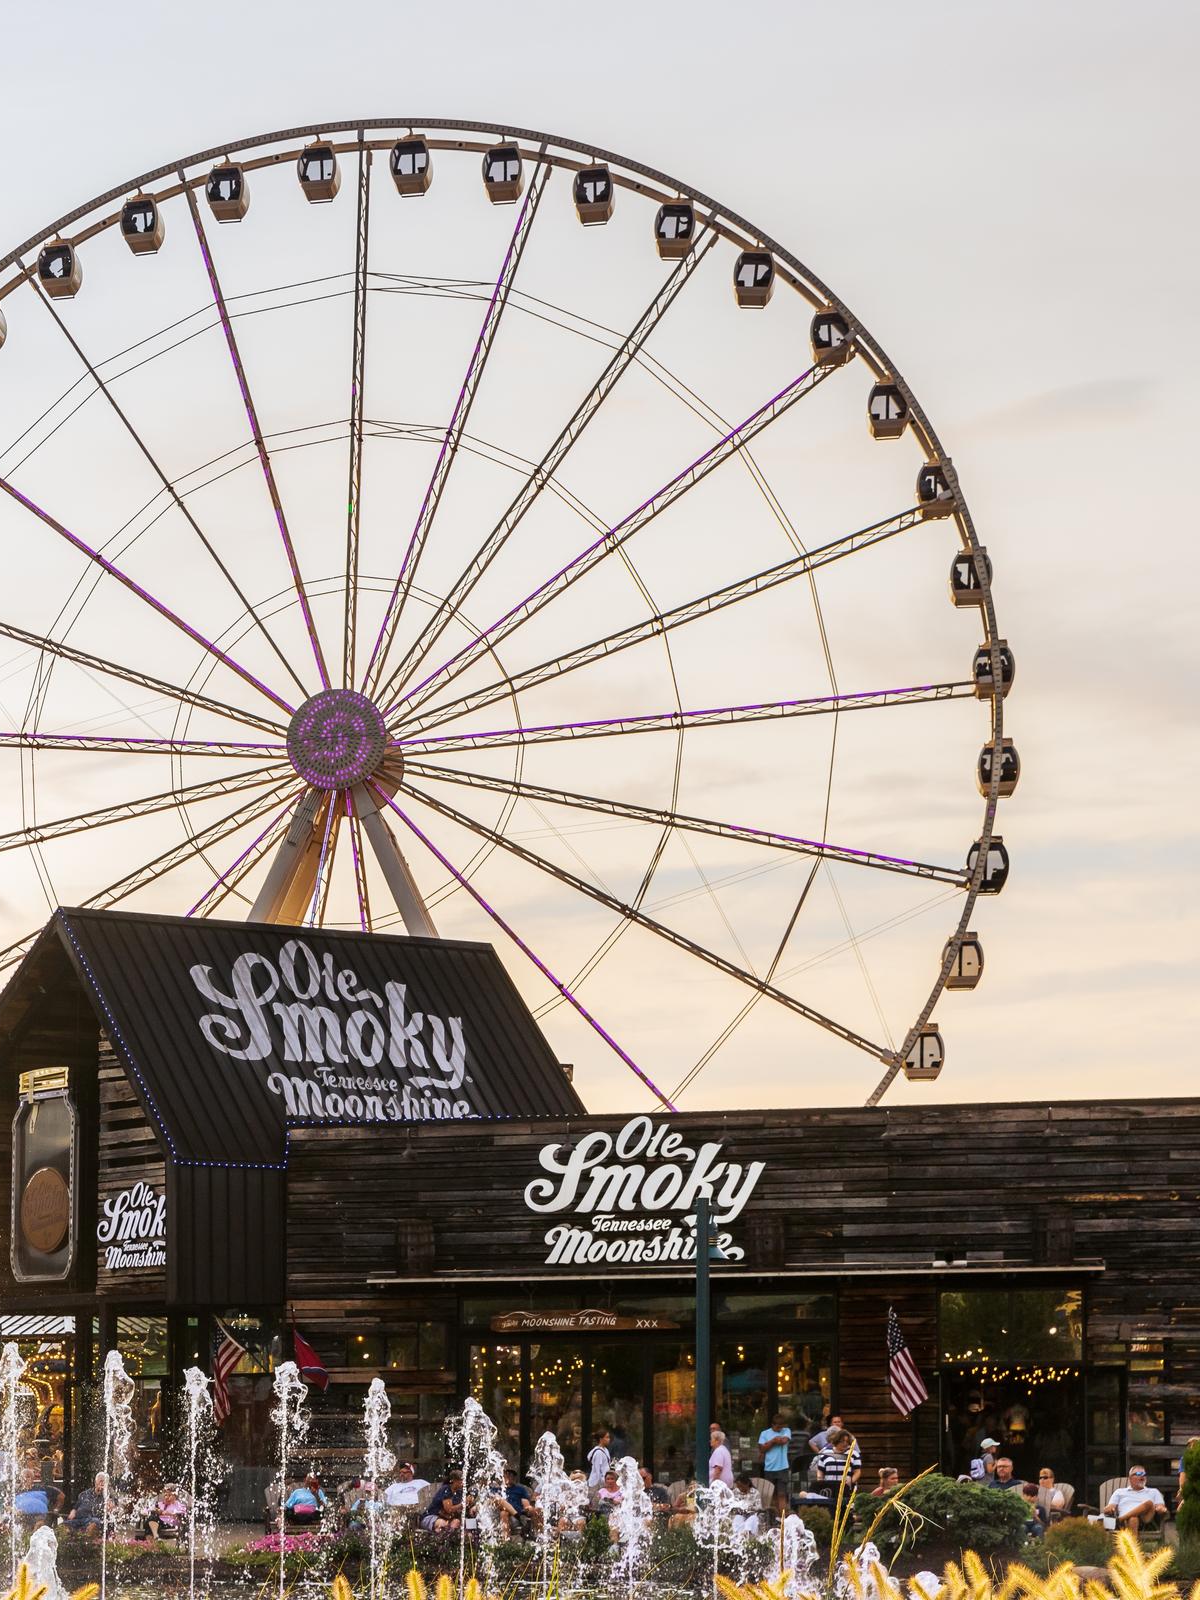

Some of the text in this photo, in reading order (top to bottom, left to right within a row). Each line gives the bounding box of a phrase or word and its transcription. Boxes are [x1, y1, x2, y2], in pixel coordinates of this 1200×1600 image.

[279, 939, 383, 1008] Ole
[190, 953, 466, 1090] Smoky
[267, 1073, 478, 1120] Moonshine
[314, 1066, 398, 1091] Tennessee
[615, 1116, 696, 1161] Ole
[130, 1182, 157, 1208] Ole
[524, 1131, 767, 1224] Smoky
[97, 1191, 166, 1246] Smok
[591, 1214, 672, 1233] Tennessee
[123, 1240, 149, 1252] Tennessee
[544, 1227, 745, 1264] Moonshie
[520, 1317, 575, 1327] MOONSHINE
[579, 1315, 617, 1327] TASTING
